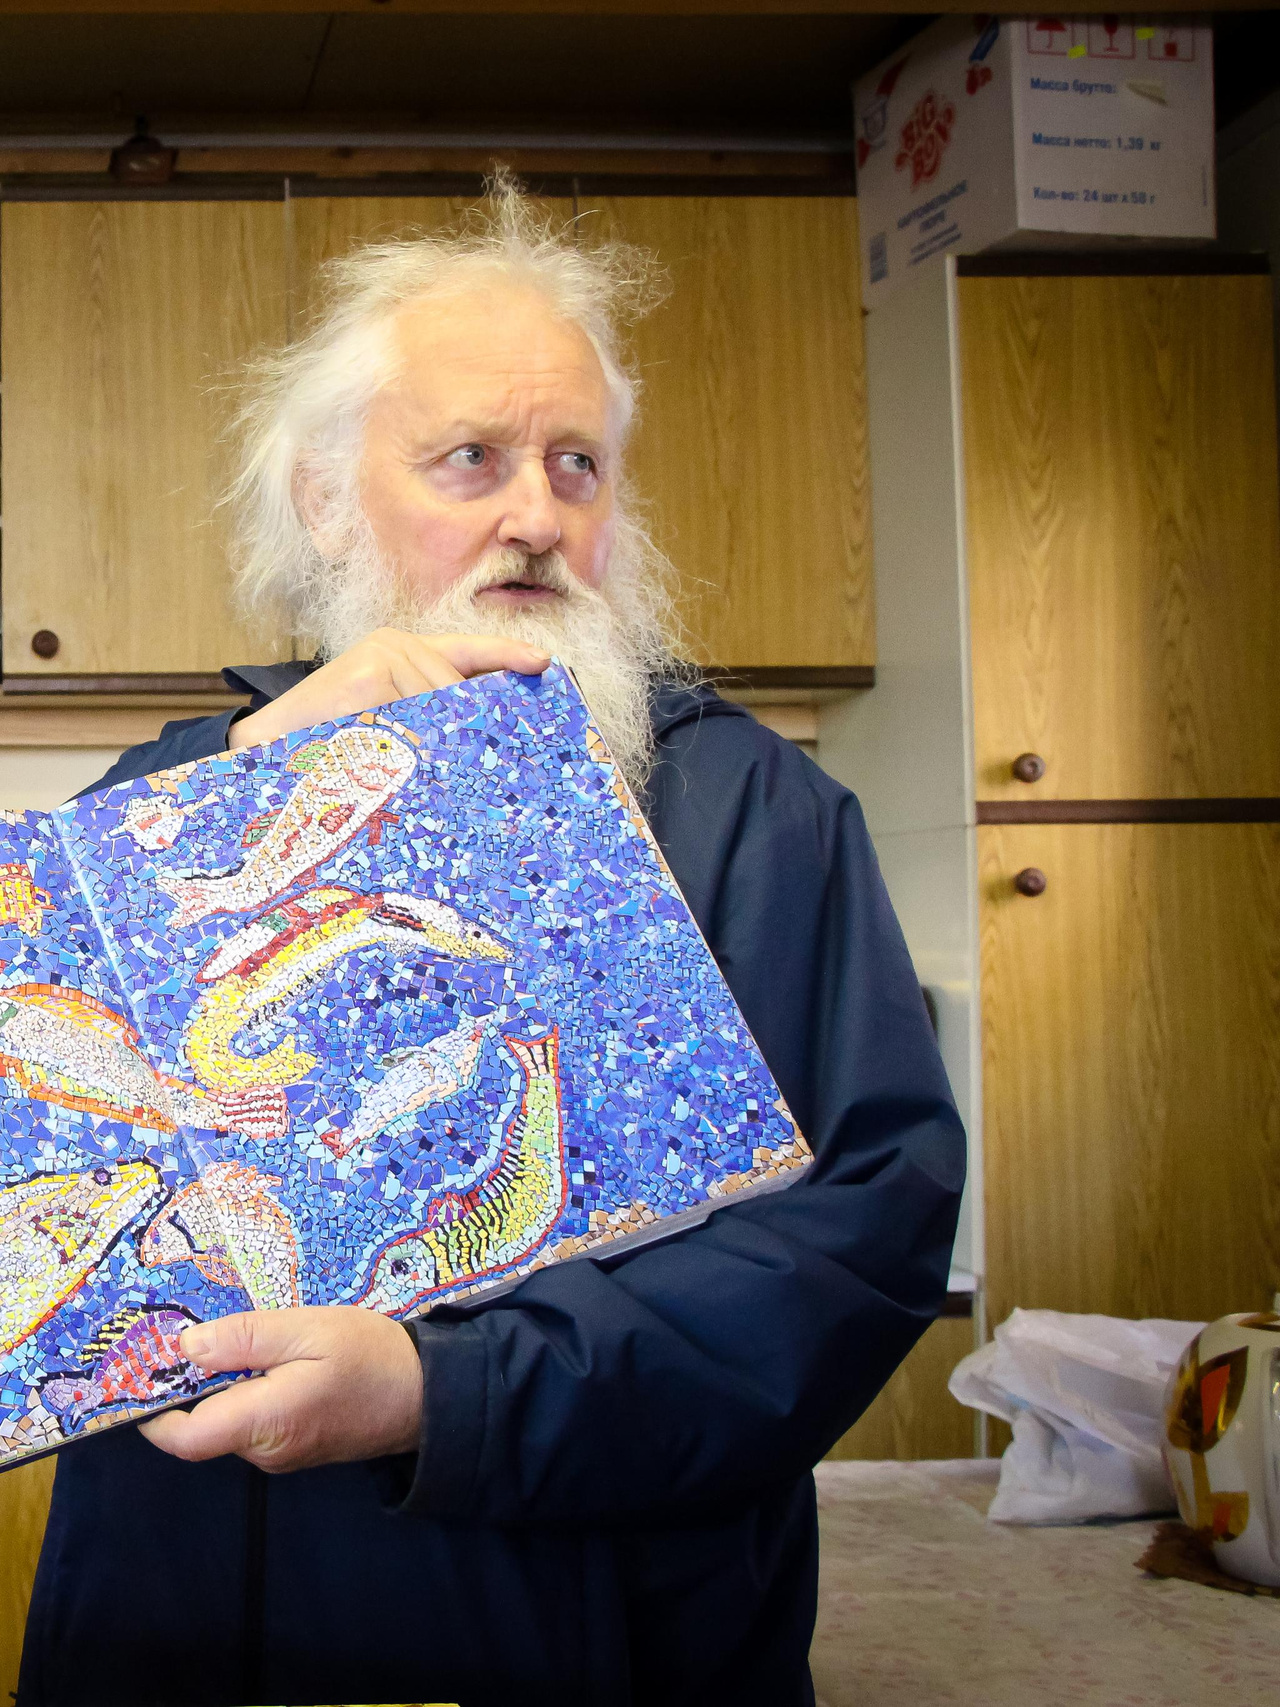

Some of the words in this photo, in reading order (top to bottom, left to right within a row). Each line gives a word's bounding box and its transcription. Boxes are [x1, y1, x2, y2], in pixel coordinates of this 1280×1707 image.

[1030, 77, 1069, 91] Масса
[1072, 78, 1117, 95] брутто:
[1032, 133, 1070, 147] Масса
[1073, 137, 1111, 149] нетто:
[1116, 136, 1145, 151] 1,39
[1149, 140, 1161, 151] кг
[1033, 186, 1078, 201] Кол-во:
[1082, 188, 1099, 202] 24
[1102, 192, 1119, 203] шт
